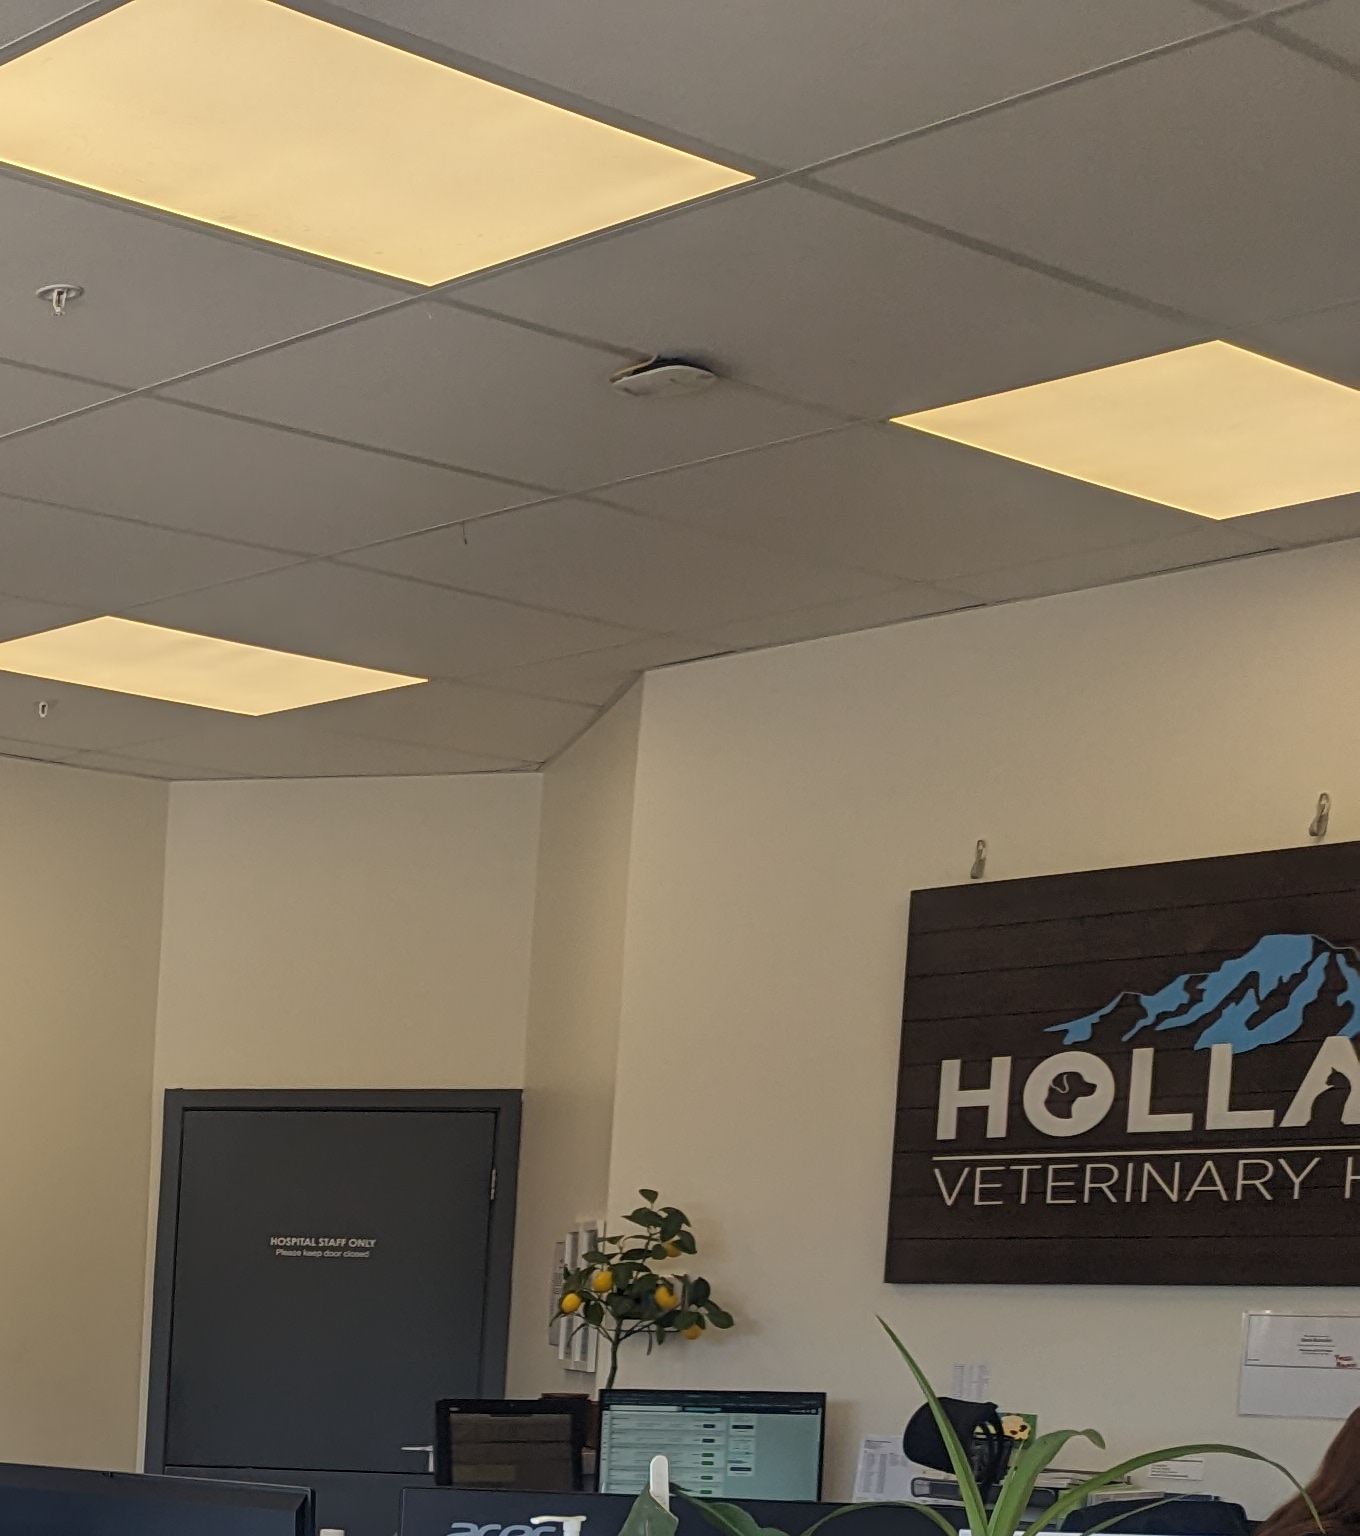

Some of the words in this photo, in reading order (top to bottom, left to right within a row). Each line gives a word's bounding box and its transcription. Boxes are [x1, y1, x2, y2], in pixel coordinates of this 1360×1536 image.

[933, 1156, 1321, 1207] VETERINARY
[270, 1236, 316, 1247] HOSPITAL
[318, 1238, 347, 1248] STAFF
[348, 1239, 377, 1248] ONLY
[275, 1248, 302, 1257] Please
[302, 1248, 322, 1258] keep
[323, 1249, 343, 1257] door
[343, 1250, 370, 1258] closed
